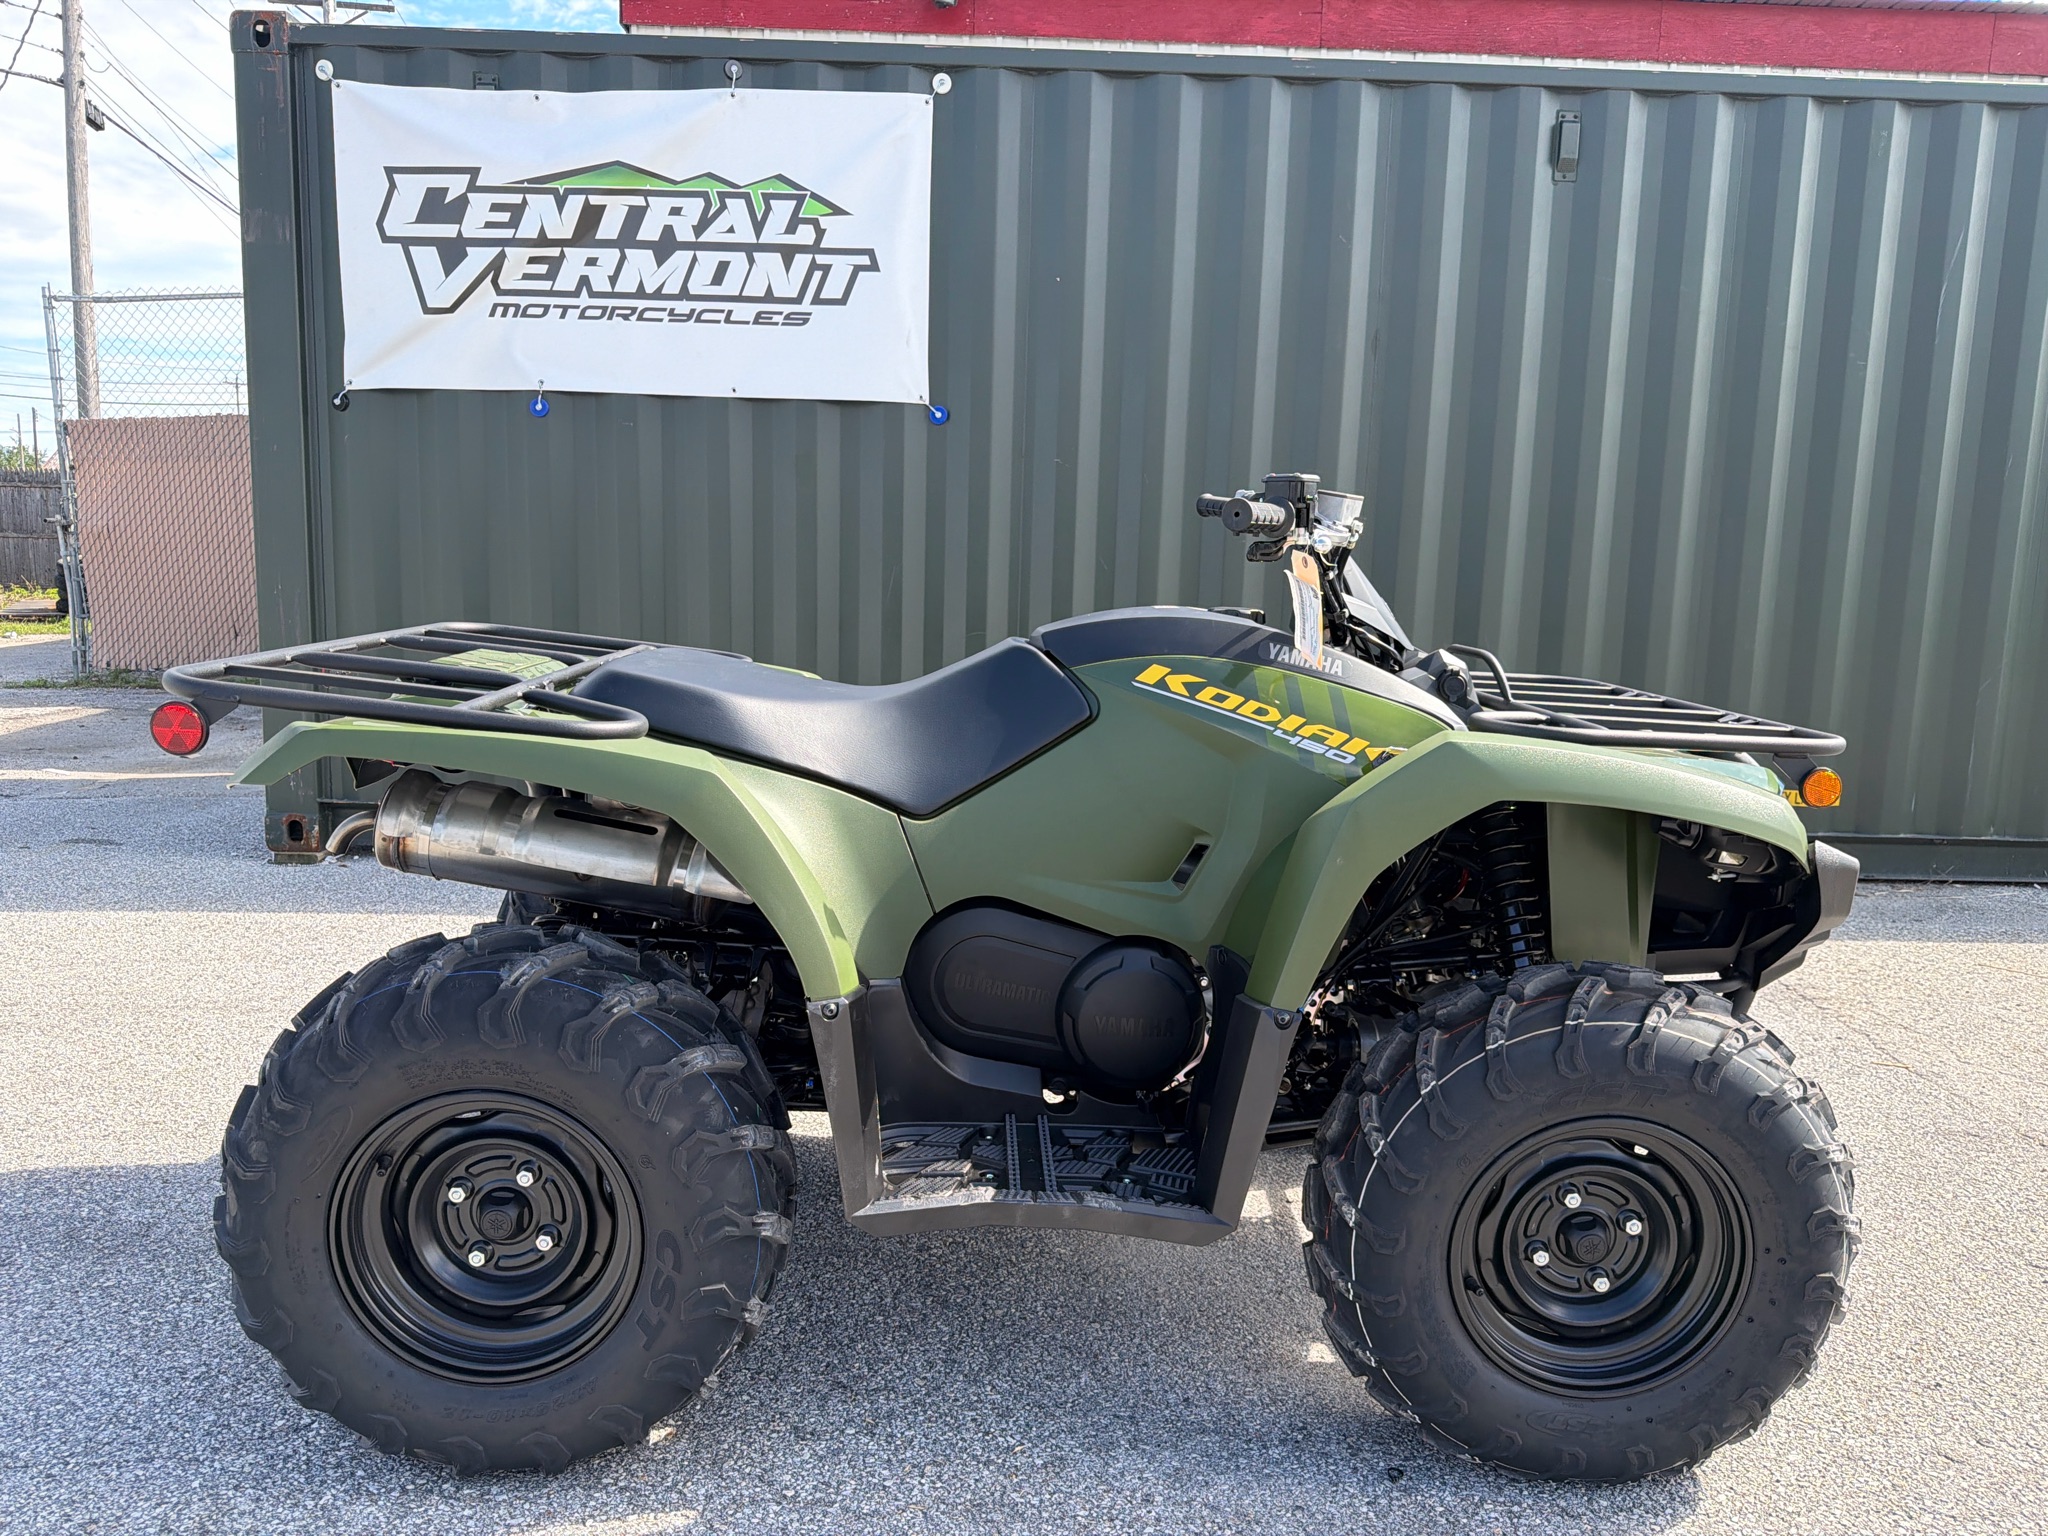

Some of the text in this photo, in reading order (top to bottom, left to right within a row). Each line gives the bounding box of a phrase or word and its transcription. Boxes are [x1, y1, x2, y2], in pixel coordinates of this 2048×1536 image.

[378, 168, 820, 245] CENTRAL
[402, 244, 879, 313] VERMONT
[488, 302, 813, 327] MOTORCYCLES
[1268, 642, 1343, 677] YAMHA
[1273, 729, 1356, 764] 450
[1094, 1015, 1175, 1039] YAMAHA
[634, 1229, 682, 1352] CST
